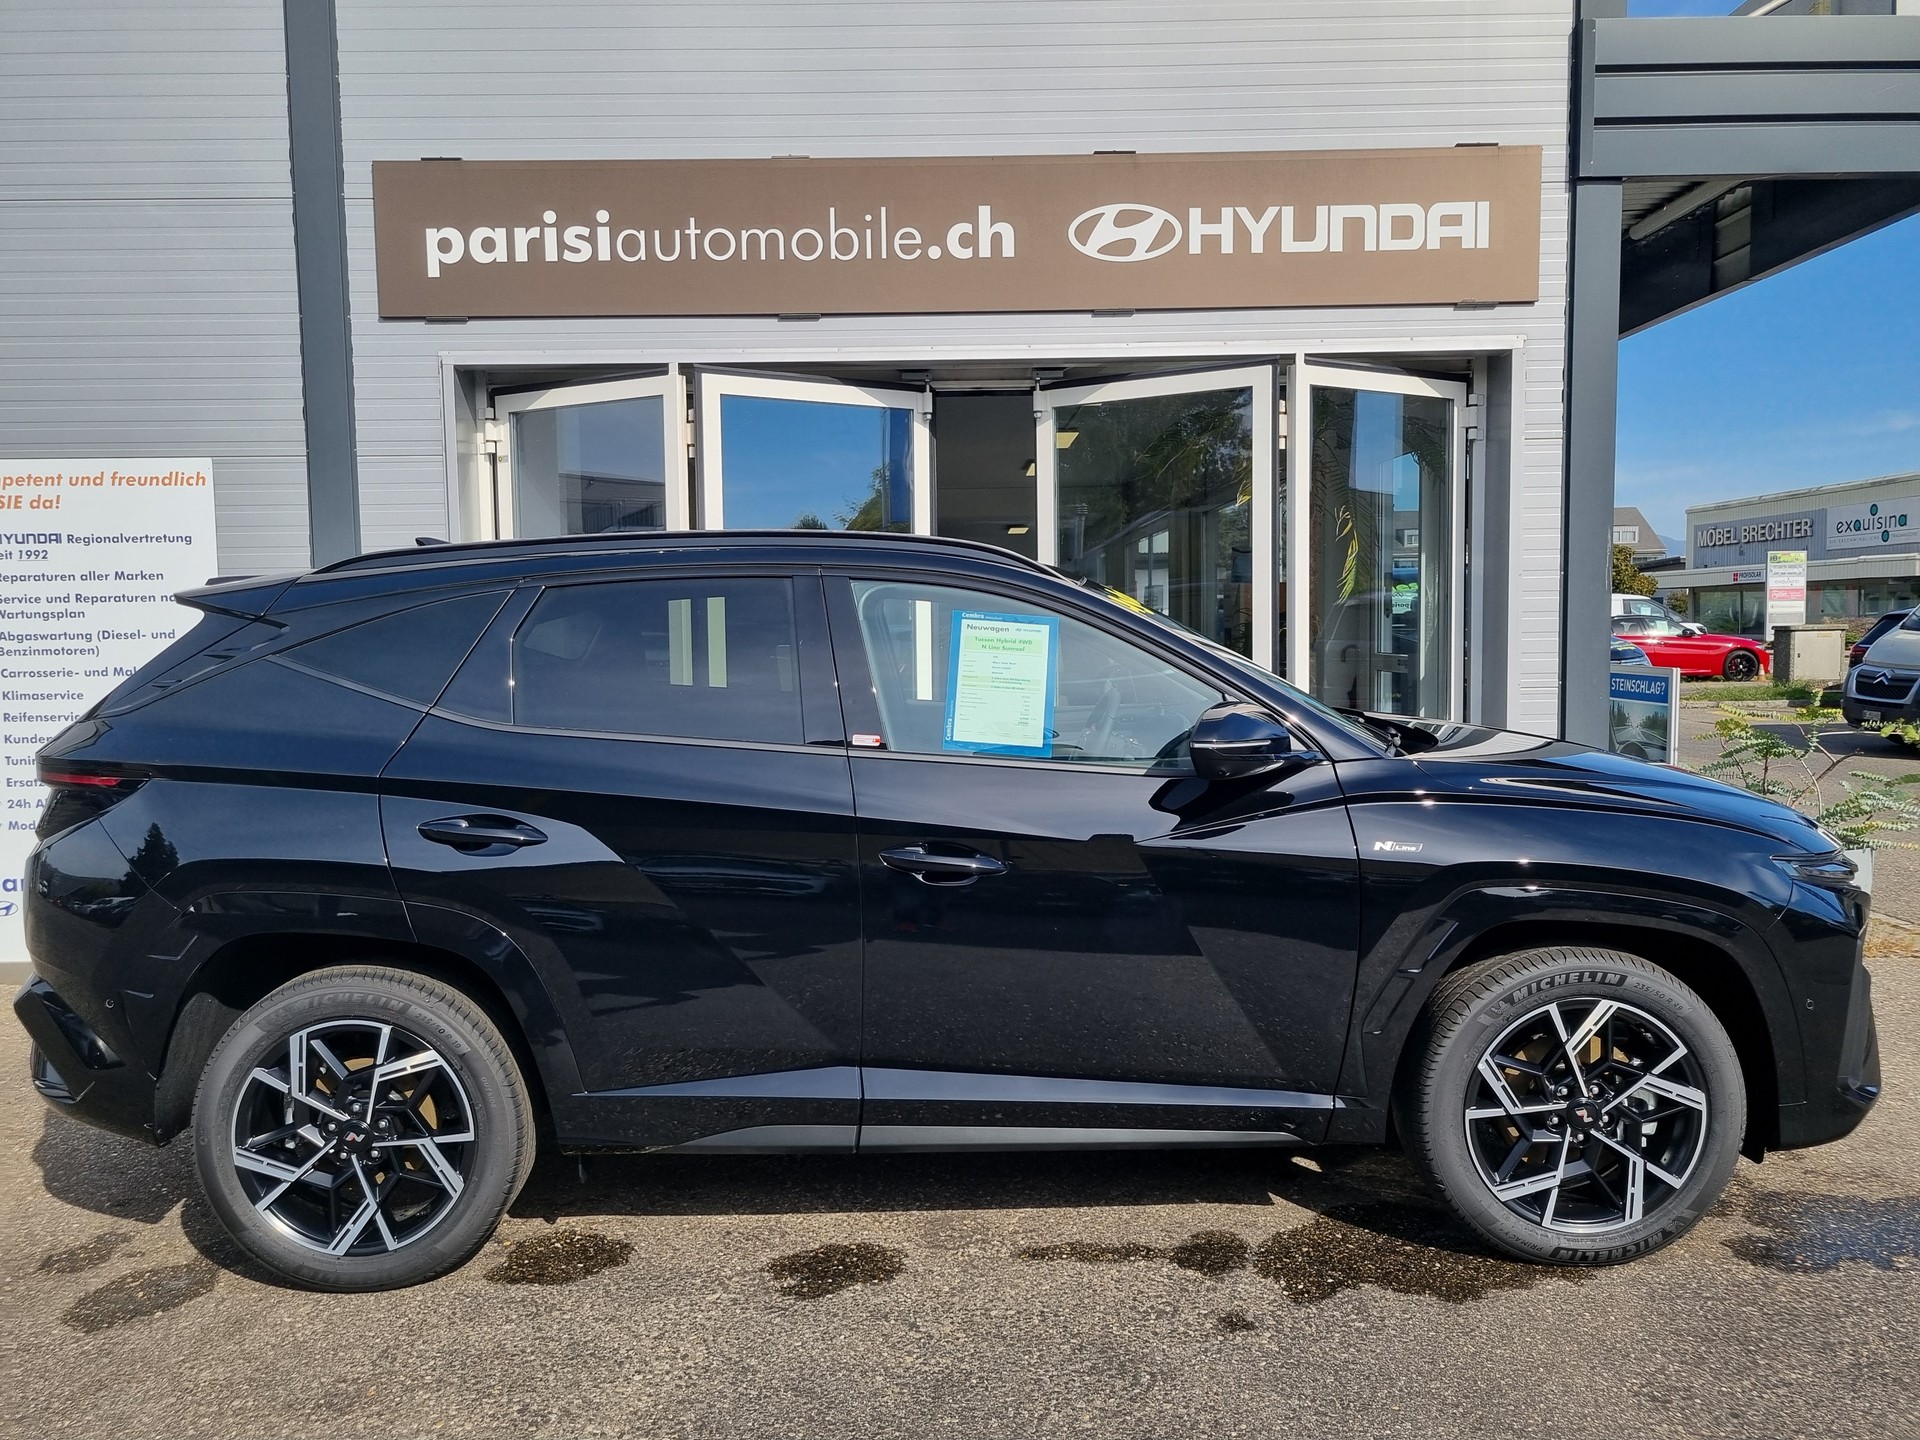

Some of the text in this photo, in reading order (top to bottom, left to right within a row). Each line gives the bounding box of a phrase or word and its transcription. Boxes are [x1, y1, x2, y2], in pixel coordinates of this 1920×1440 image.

[425, 201, 1489, 278] parisiautomobile.ch HYUNDAI
[0, 471, 207, 490] petent und freundlich
[0, 494, 61, 510] SIE da!
[1836, 504, 1907, 533] exquisina
[1697, 518, 1814, 547] MÖBEL BRECHTER
[67, 533, 192, 546] Regionalvertretung
[0, 549, 48, 560] eit 1992
[80, 571, 110, 581] aller
[114, 570, 164, 580] Marken
[46, 593, 70, 604] und
[75, 593, 156, 606] Reparaturen
[160, 594, 176, 603] na
[962, 611, 985, 620] Cembra
[966, 623, 1010, 634] Neuwagen
[0, 629, 175, 643] Abgaswartung (Diesel- und
[996, 637, 1017, 646] Hybrid
[0, 646, 100, 658] Benzinmotoren)
[1, 667, 137, 678] Carrosserie- und Mal
[1611, 678, 1666, 695] STEINSCHLAG?
[2, 690, 84, 701] Klimaservice
[3, 712, 81, 723] Reifenservic
[6, 777, 46, 788] Ersatz
[7, 798, 32, 809] 24h
[8, 820, 38, 831] Mod
[1374, 841, 1394, 852] N
[1513, 972, 1620, 1003] MICHELIN
[1633, 982, 1666, 1000] 235/50
[415, 1012, 445, 1034] 235/50
[452, 1040, 462, 1050] 19
[1504, 1230, 1544, 1252] PRIMACY
[1557, 1231, 1664, 1261] MICHELIN
